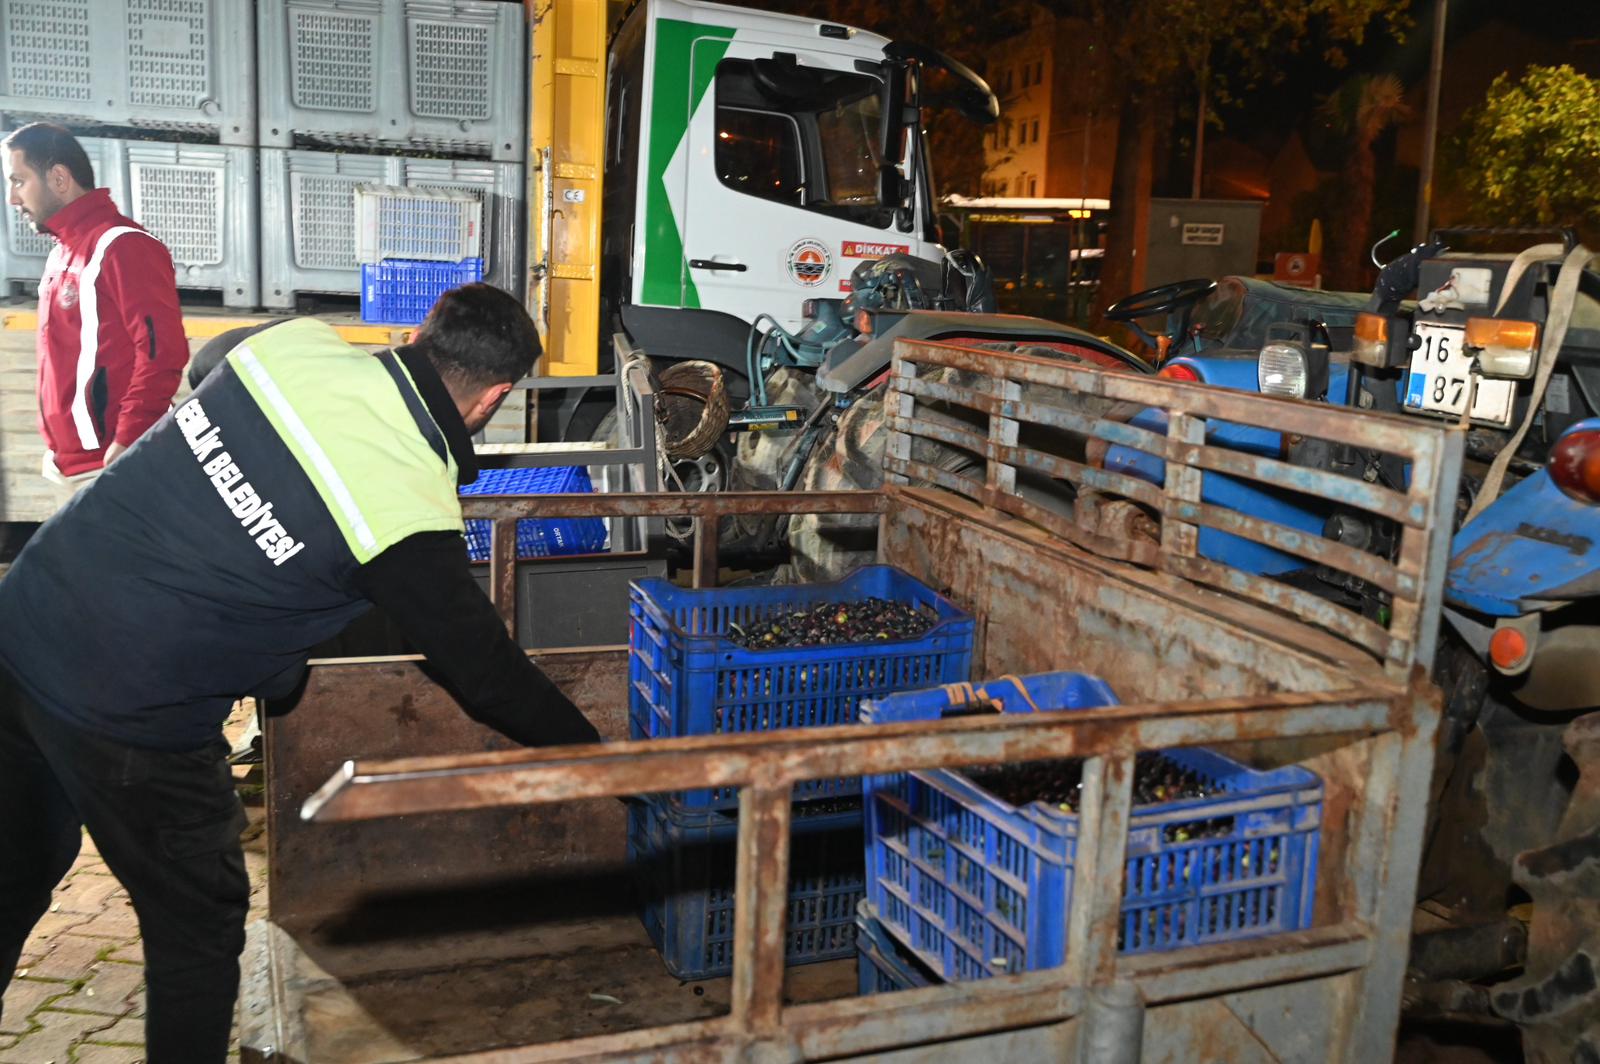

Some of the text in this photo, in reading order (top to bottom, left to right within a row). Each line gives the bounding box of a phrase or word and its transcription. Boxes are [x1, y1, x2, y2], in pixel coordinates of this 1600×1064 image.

[855, 243, 898, 255] DİKKAT
[1425, 336, 1449, 362] 16
[202, 451, 305, 567] BELEDİYESİ
